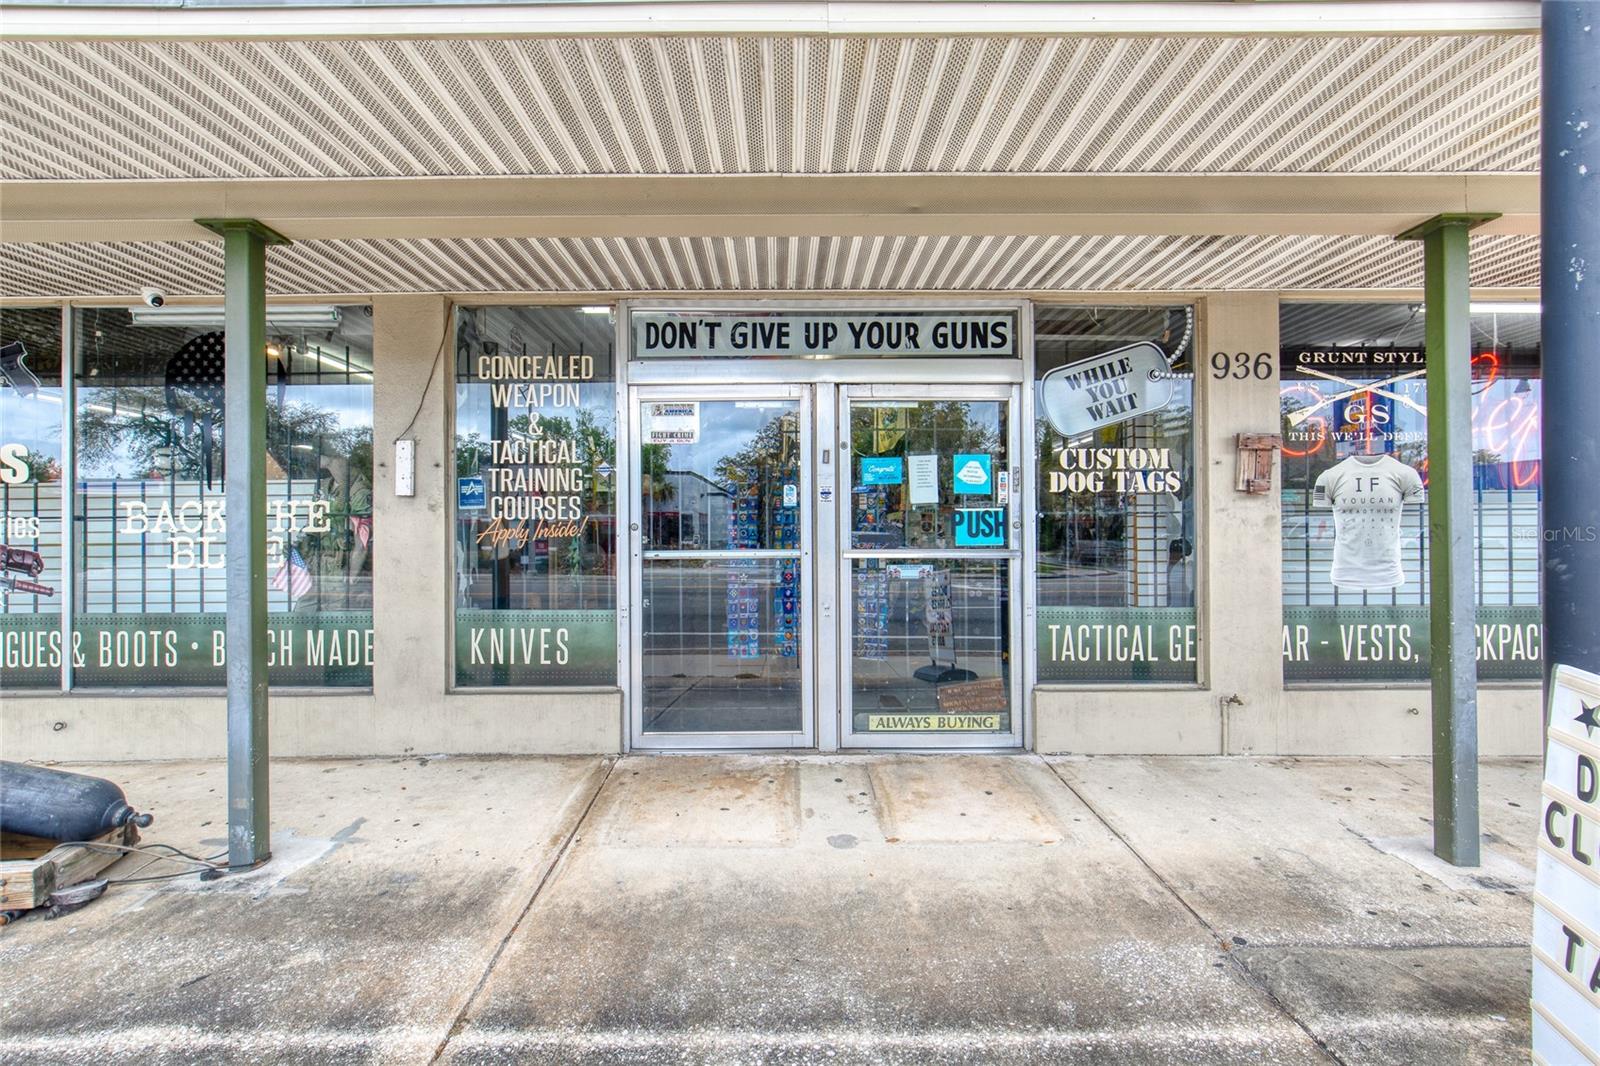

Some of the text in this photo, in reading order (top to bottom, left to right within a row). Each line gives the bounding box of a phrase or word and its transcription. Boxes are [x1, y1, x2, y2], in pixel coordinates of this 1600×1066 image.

[645, 318, 1008, 350] DON'T GIVE UP YOUR GUNS
[478, 355, 594, 380] CONCEALED
[1210, 351, 1273, 381] 936
[1298, 351, 1428, 364] GRUNT STYL
[1063, 356, 1133, 393] WHILE
[491, 383, 580, 408] WEAPON
[1085, 377, 1128, 406] YOU
[1086, 393, 1138, 424] WAIT
[1343, 403, 1391, 425] GS
[528, 411, 544, 436] &
[1288, 432, 1428, 441] THIS WE'LL DEFE
[490, 440, 583, 464] TACTICAL
[1059, 448, 1170, 470] CUSTOM
[488, 468, 584, 493] TRAINING
[1049, 472, 1182, 495] DOG TAGS
[1355, 477, 1380, 492] IF
[120, 499, 331, 534] BACK HE
[491, 496, 581, 520] COURSES
[0, 511, 40, 538] ies
[476, 515, 589, 548] Apply Inside!
[951, 510, 1008, 538] PUSH
[167, 536, 284, 569] BLE
[73, 631, 86, 668] &
[100, 631, 178, 668] BOOTS
[213, 630, 375, 667] BCH MADE
[470, 628, 569, 665] KNIVES
[1048, 624, 1159, 662] TACTICAL
[1340, 624, 1420, 665] VESTS,
[875, 716, 993, 730] ALWAYS BUYING
[1545, 799, 1600, 866] CL
